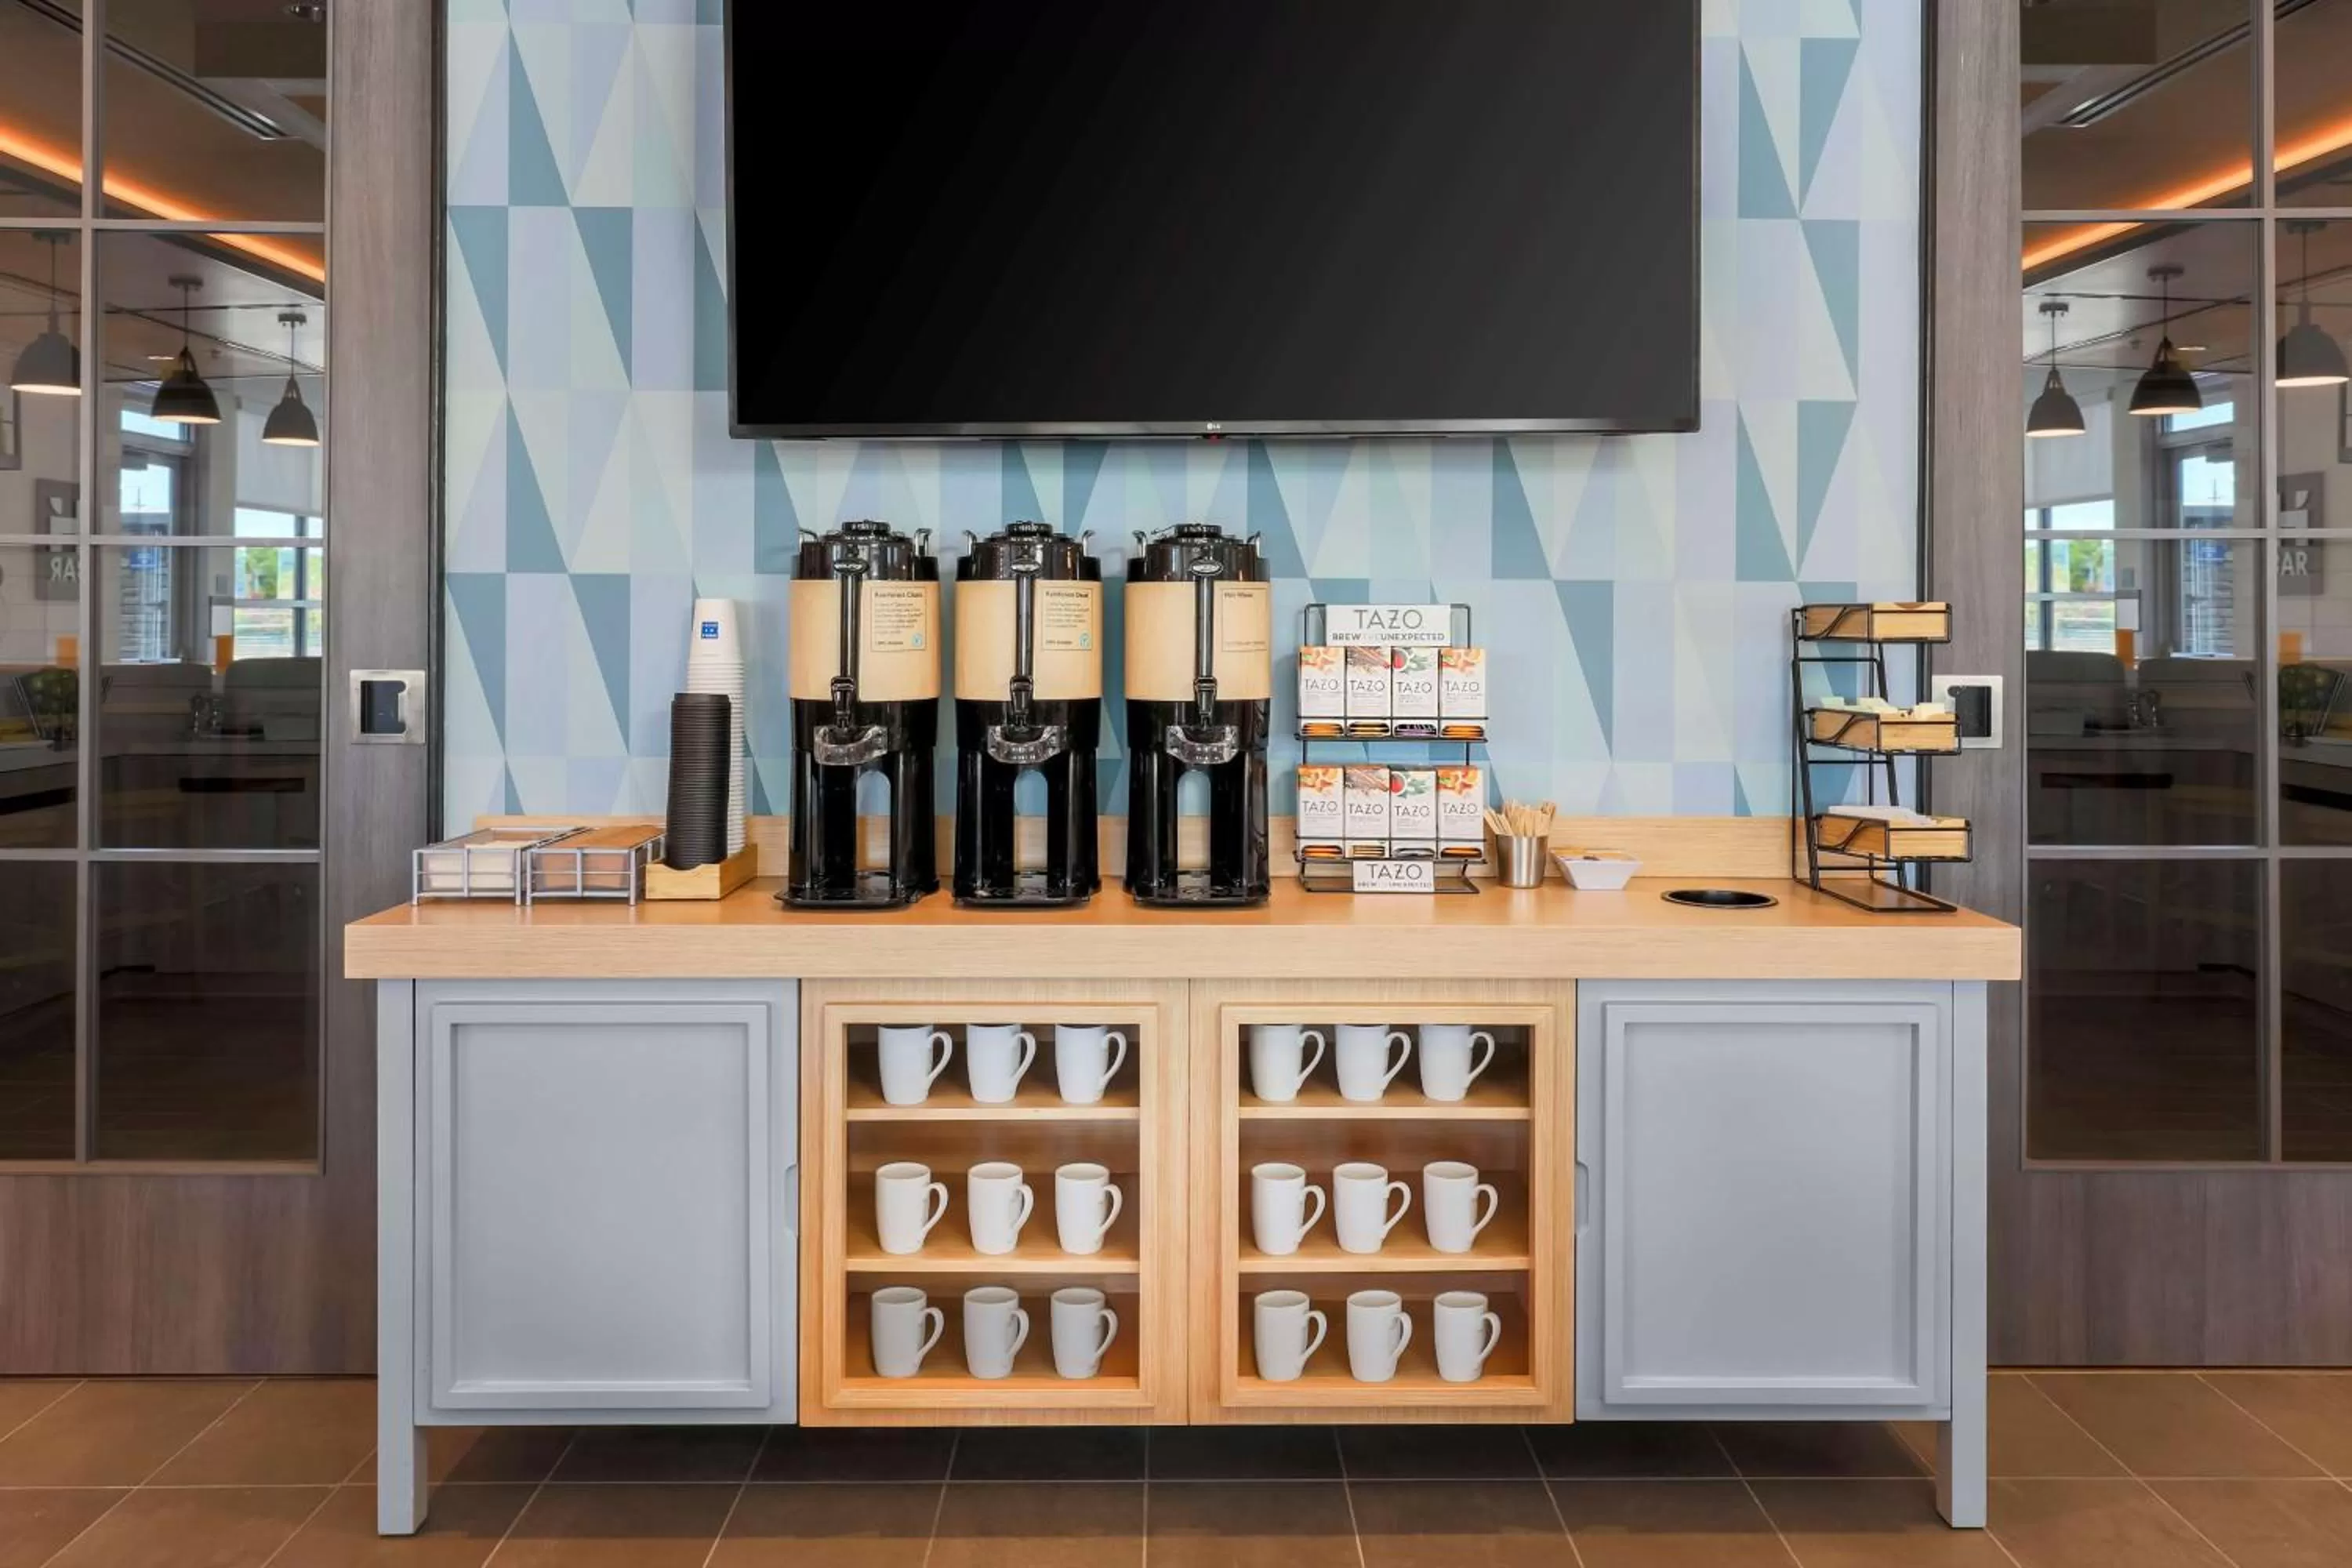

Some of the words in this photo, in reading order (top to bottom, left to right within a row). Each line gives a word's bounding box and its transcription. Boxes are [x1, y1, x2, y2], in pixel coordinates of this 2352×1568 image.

[1353, 609, 1423, 630] TAZO
[1305, 678, 1339, 691] TAZO
[1349, 680, 1385, 692] TAZO
[1397, 681, 1432, 694] TAZO
[1444, 681, 1480, 691] TAZO
[1302, 800, 1338, 812] TAZO
[1348, 803, 1384, 815] TAZO
[1394, 805, 1430, 817] TAZO
[1443, 802, 1478, 815] TAZO
[1367, 864, 1423, 880] TAZO
